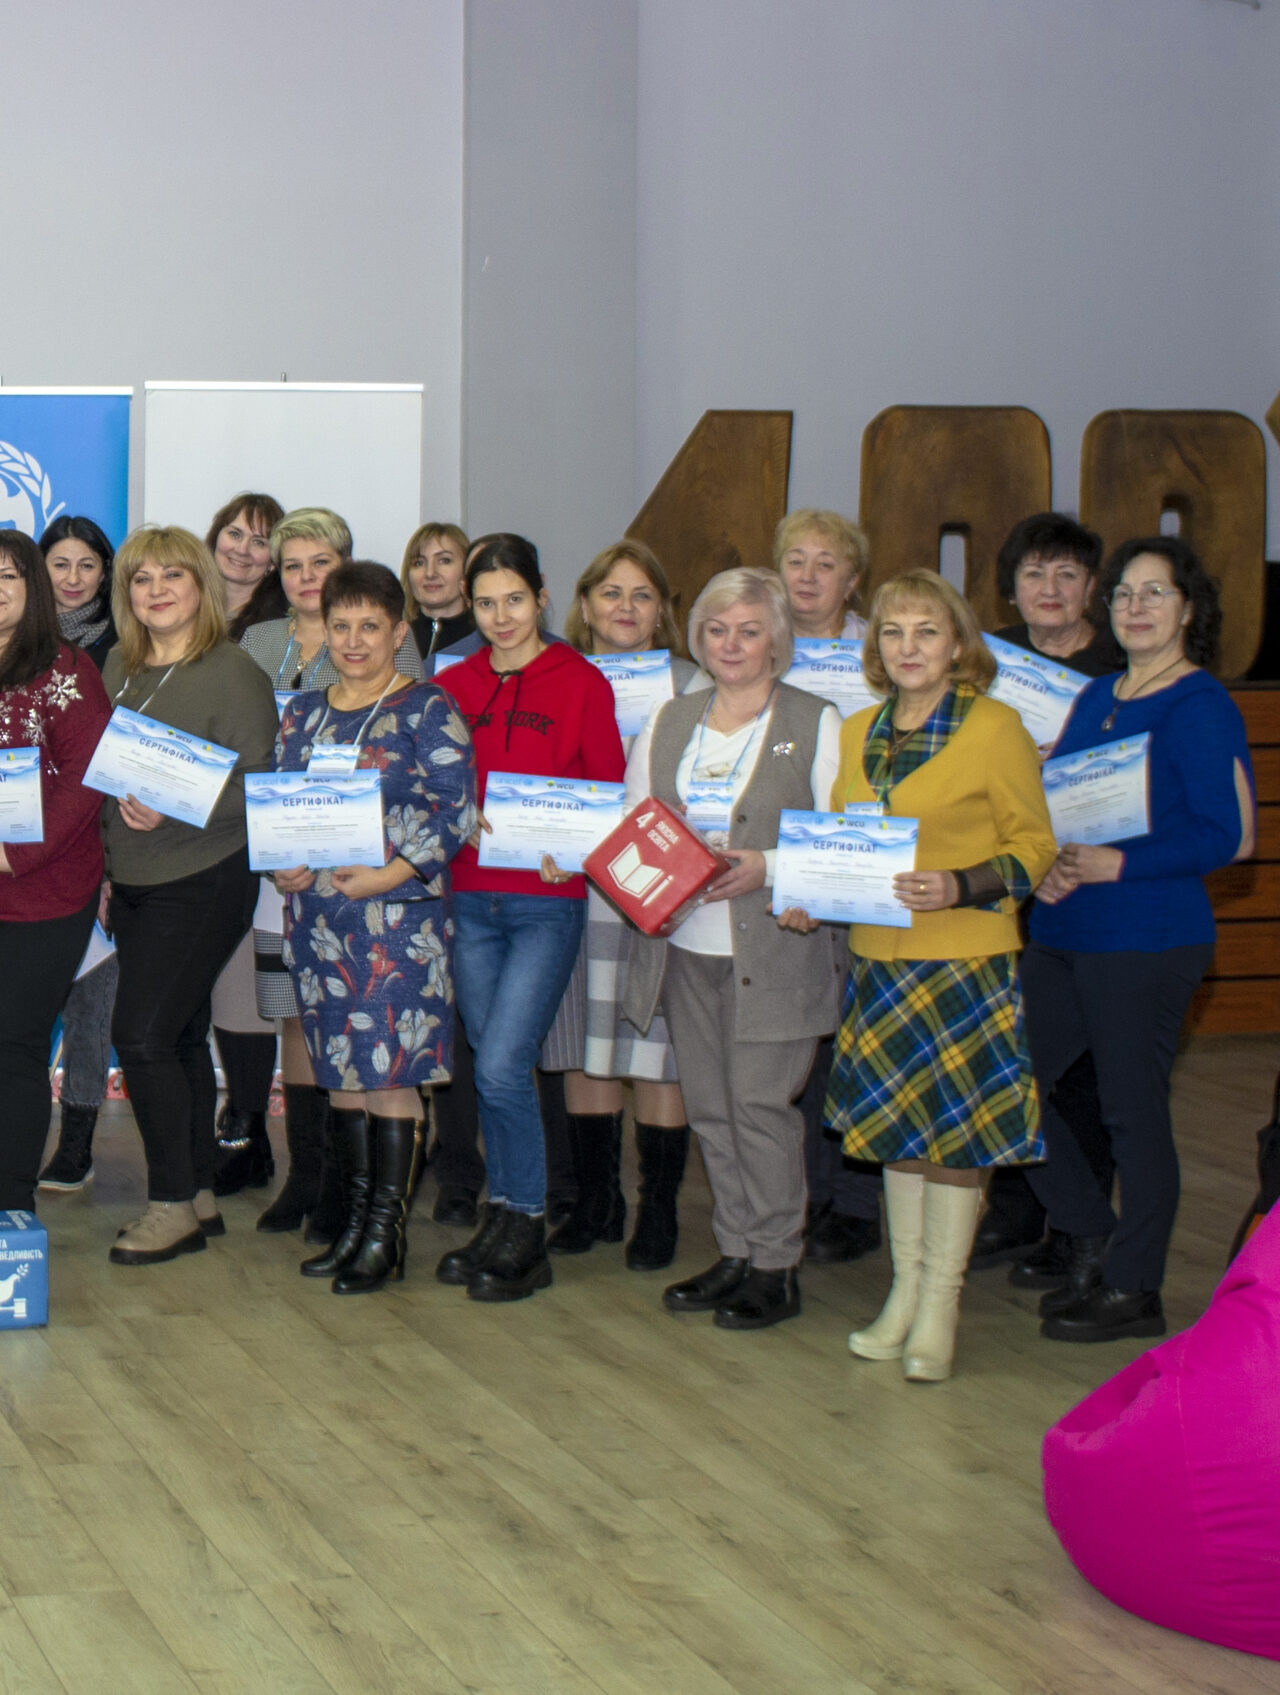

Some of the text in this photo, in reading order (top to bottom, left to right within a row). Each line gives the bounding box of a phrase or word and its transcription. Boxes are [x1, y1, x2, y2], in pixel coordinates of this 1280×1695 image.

[999, 668, 1049, 695] ЕРТИФІКАТ
[504, 709, 555, 735] YORK
[139, 737, 197, 764] СЕРТИФІКАТ
[1068, 767, 1116, 787] СЕРТИФІКАТ
[282, 796, 344, 807] СЕРТИФІКАТ
[522, 799, 584, 811] СЕРТИФІКАТ
[636, 811, 655, 828] 4
[846, 820, 865, 828] WCU
[813, 840, 876, 853] СЕРТИФІКАТ
